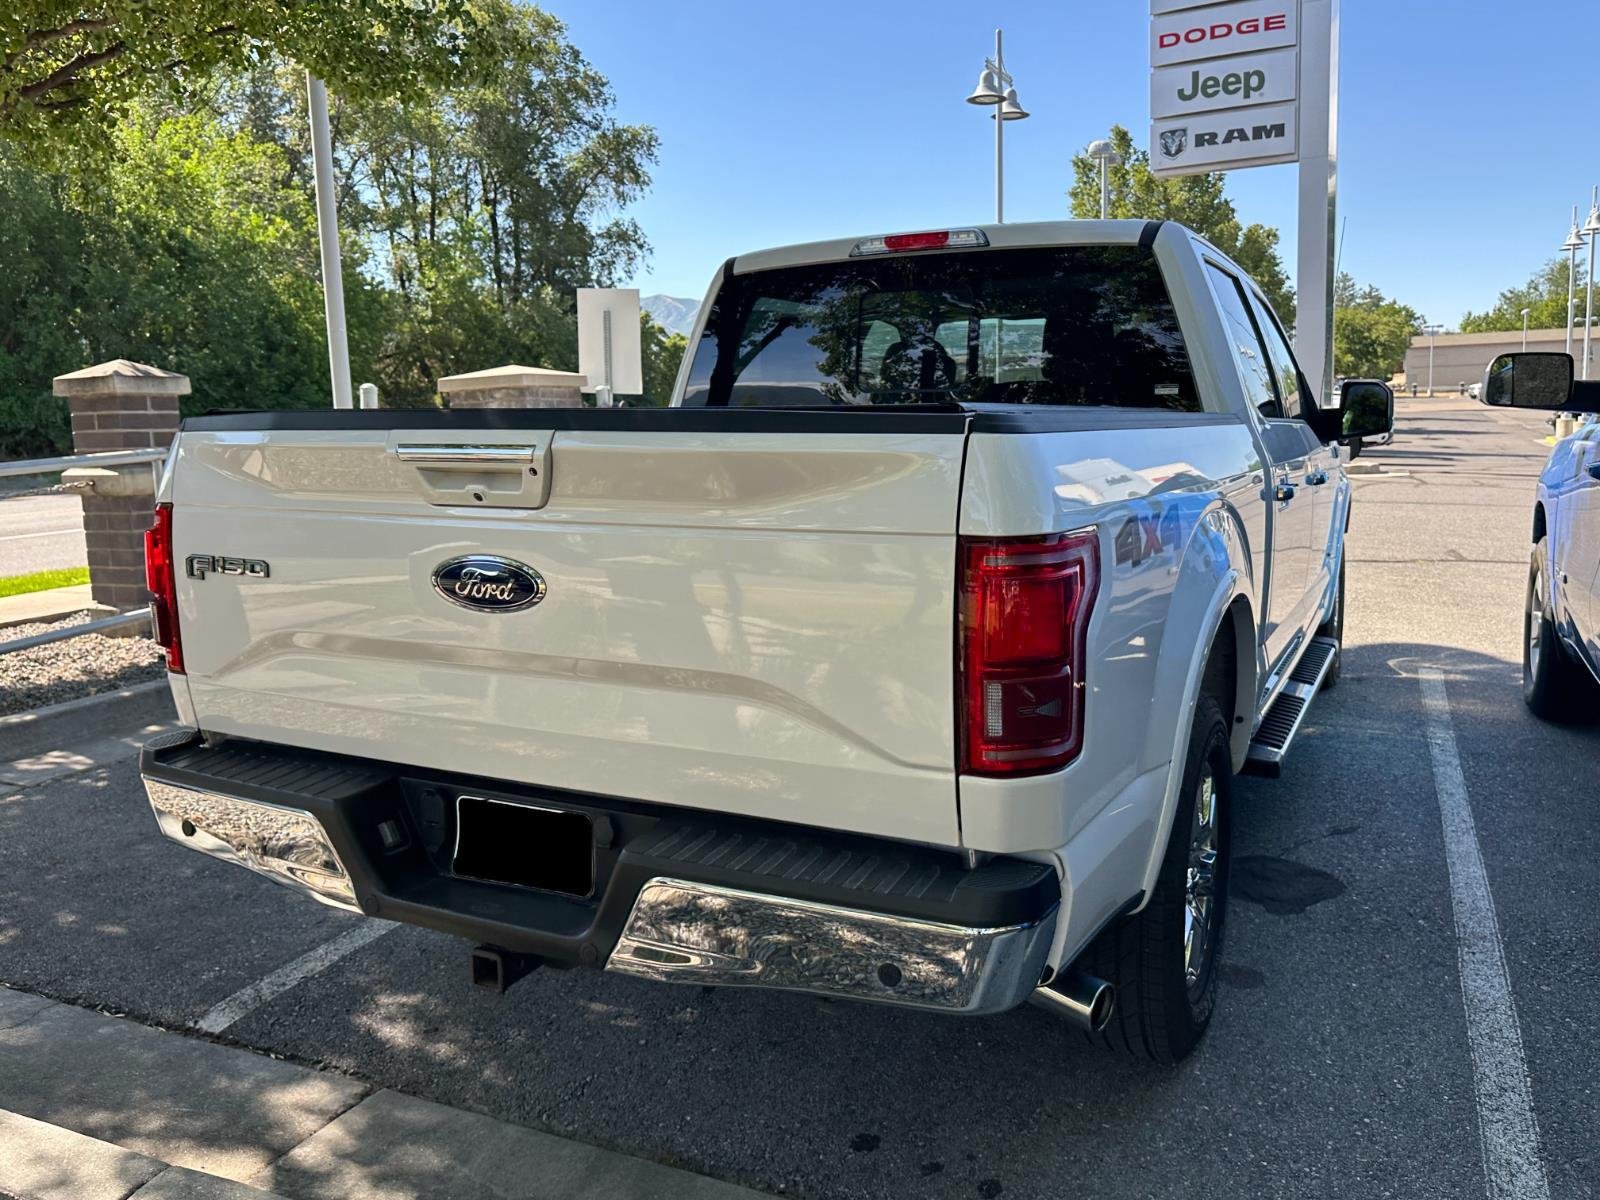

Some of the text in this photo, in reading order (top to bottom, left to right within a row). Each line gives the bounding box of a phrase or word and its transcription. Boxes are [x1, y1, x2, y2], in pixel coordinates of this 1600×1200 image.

[1159, 14, 1286, 48] DODGE
[1177, 69, 1265, 101] Jeep
[1194, 123, 1285, 147] RAM
[455, 567, 515, 600] Ford
